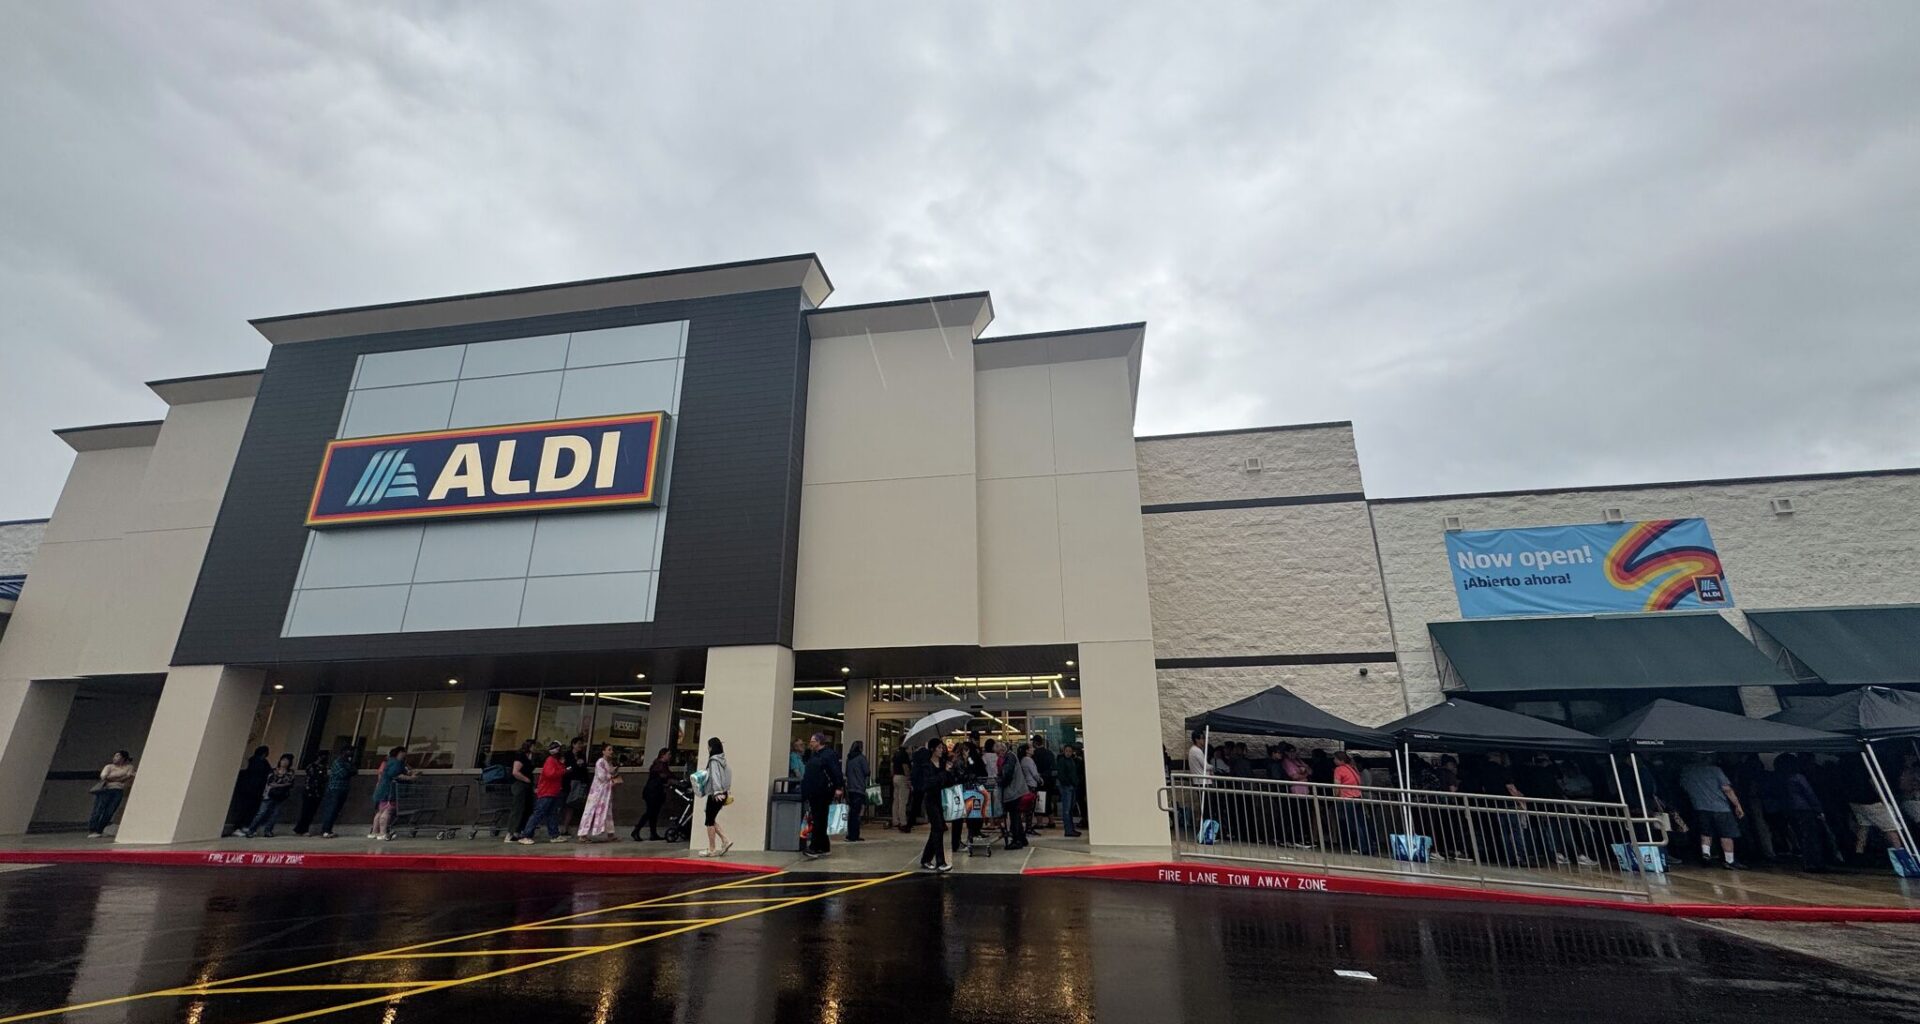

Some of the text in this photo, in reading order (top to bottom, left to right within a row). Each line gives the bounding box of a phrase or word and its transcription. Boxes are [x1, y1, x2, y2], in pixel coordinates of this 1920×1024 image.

[427, 431, 622, 501] ALDI
[1457, 544, 1593, 571] Now open!
[1463, 573, 1572, 590] ¡Abierto ahora!
[208, 853, 304, 864] FIRE LANE TOW AWAY ZONE
[1159, 869, 1329, 891] FIRE LANE TOW AWAY ZONE
